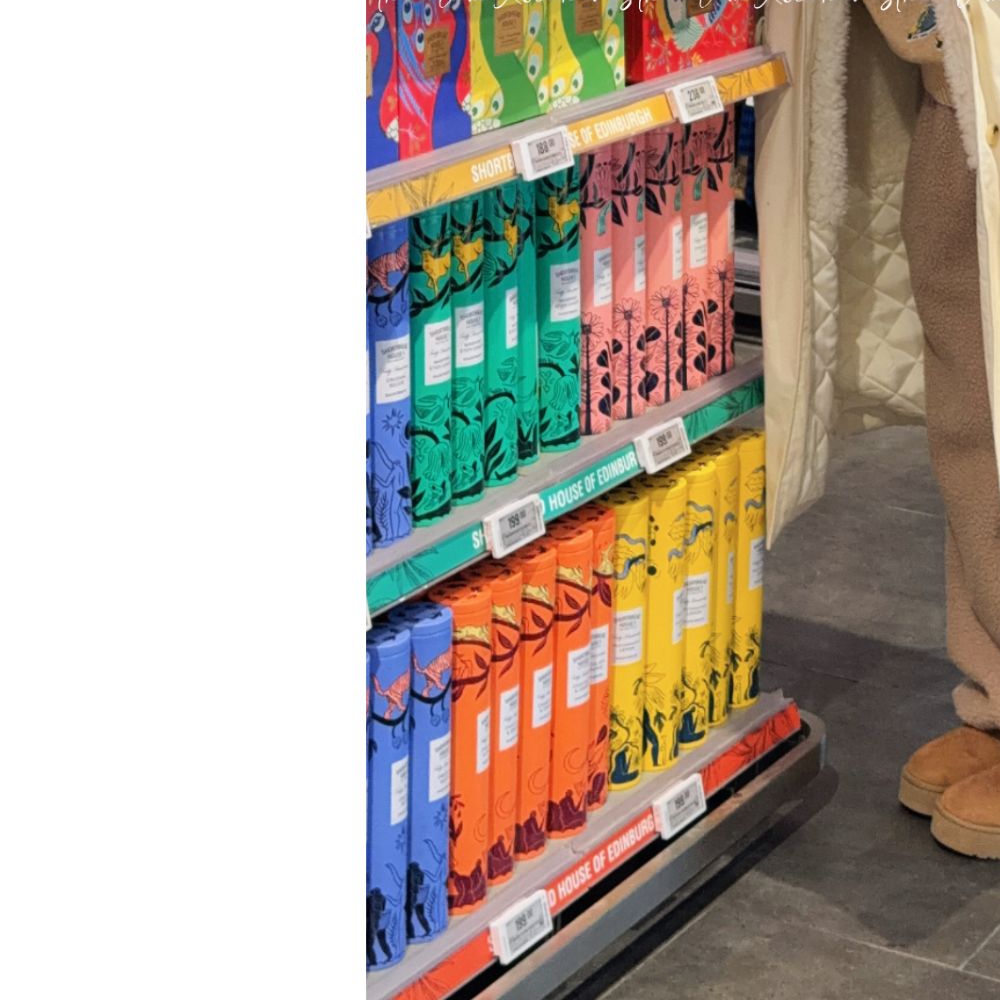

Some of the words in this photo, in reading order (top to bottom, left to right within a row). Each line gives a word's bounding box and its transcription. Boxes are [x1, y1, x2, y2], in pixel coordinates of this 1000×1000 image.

[471, 153, 515, 183] SHORT
[580, 127, 595, 144] OF
[594, 107, 654, 140] EDINBURGH
[548, 481, 584, 512] HOUSE
[584, 473, 598, 493] OF
[598, 451, 638, 484] EDINBUR
[558, 862, 593, 903] HOUSE
[593, 853, 607, 873] OF
[608, 814, 656, 863] EDINBURG
